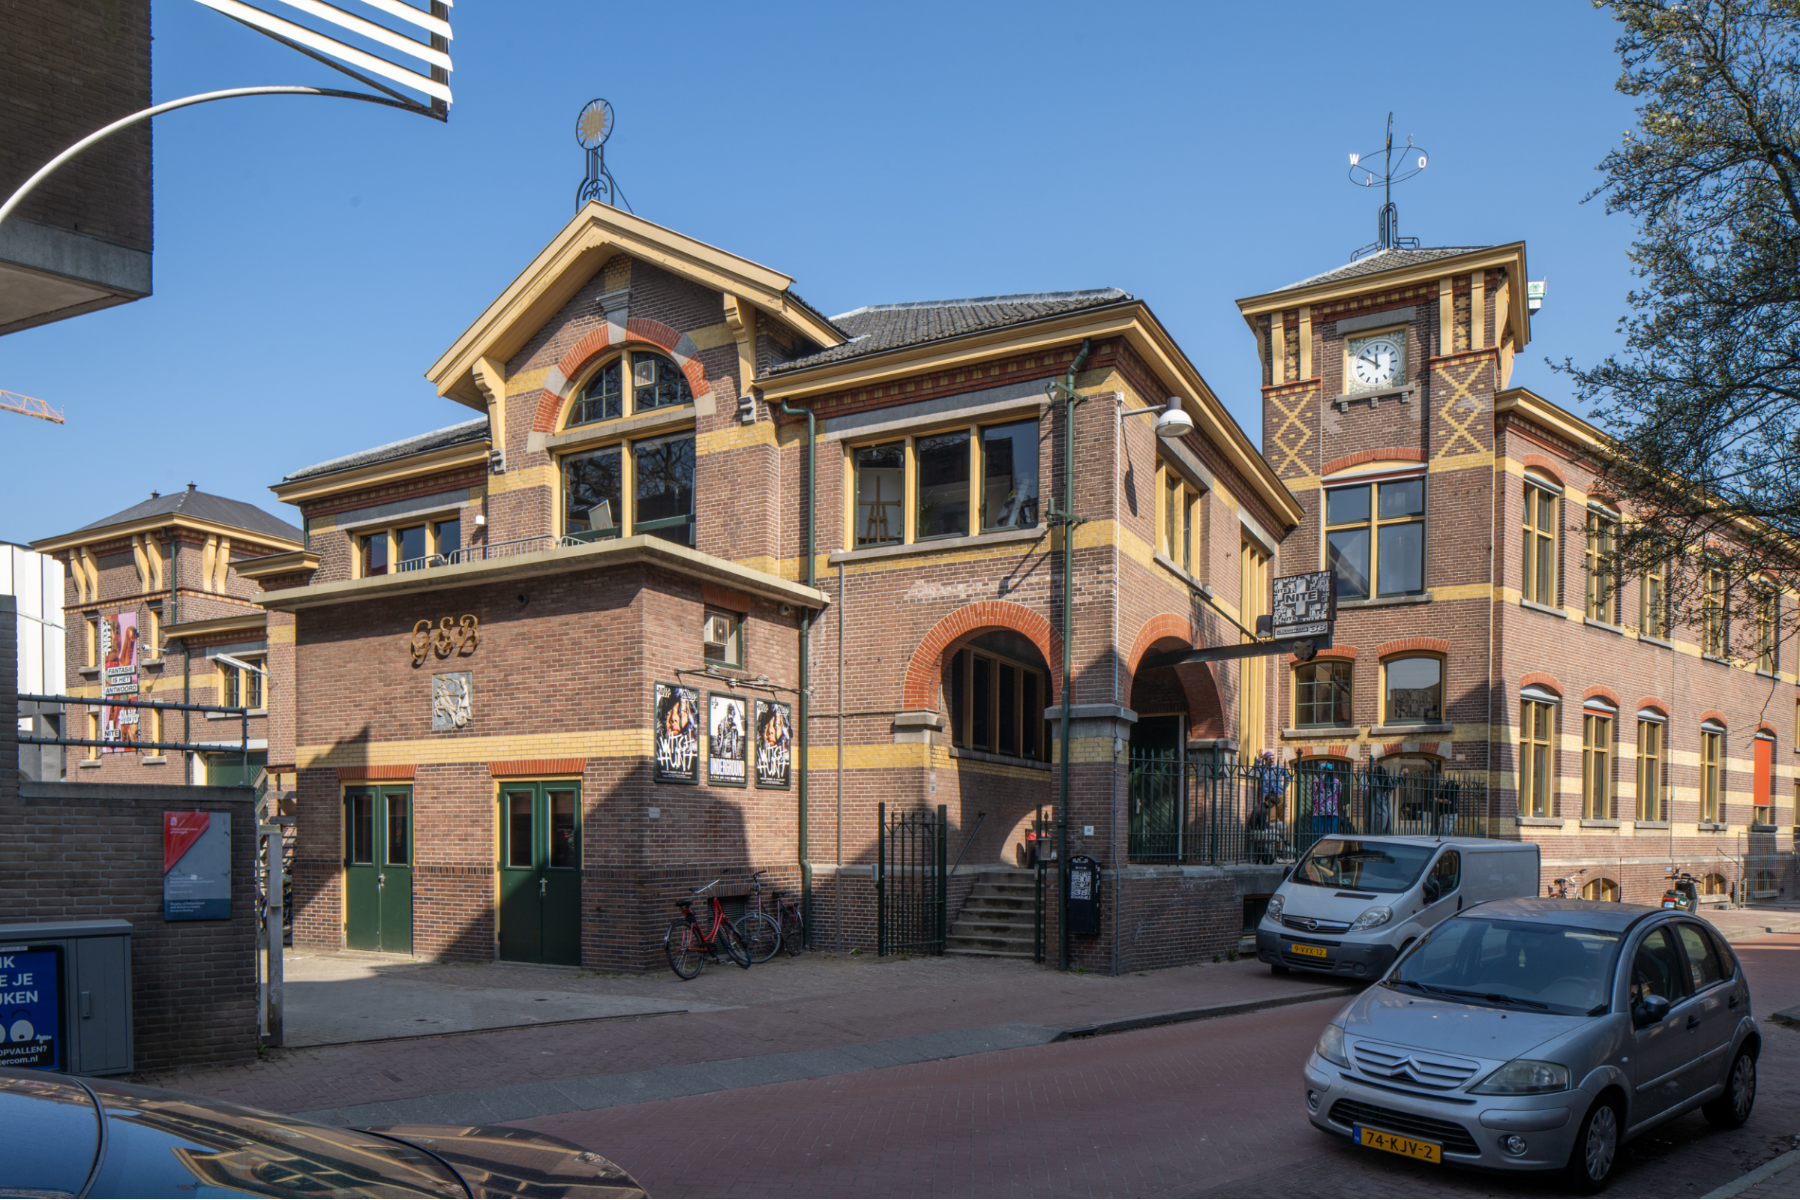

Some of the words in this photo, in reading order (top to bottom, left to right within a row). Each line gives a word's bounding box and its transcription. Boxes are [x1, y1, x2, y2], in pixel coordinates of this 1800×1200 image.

[1285, 591, 1317, 603] NITE
[108, 666, 134, 674] FANTASIE
[106, 685, 137, 694] ANTWOORD
[710, 757, 746, 777] UNDERGROUND
[12, 973, 33, 986] JE
[0, 990, 38, 1005] KEN
[1366, 1131, 1433, 1159] 74-KJV-2
